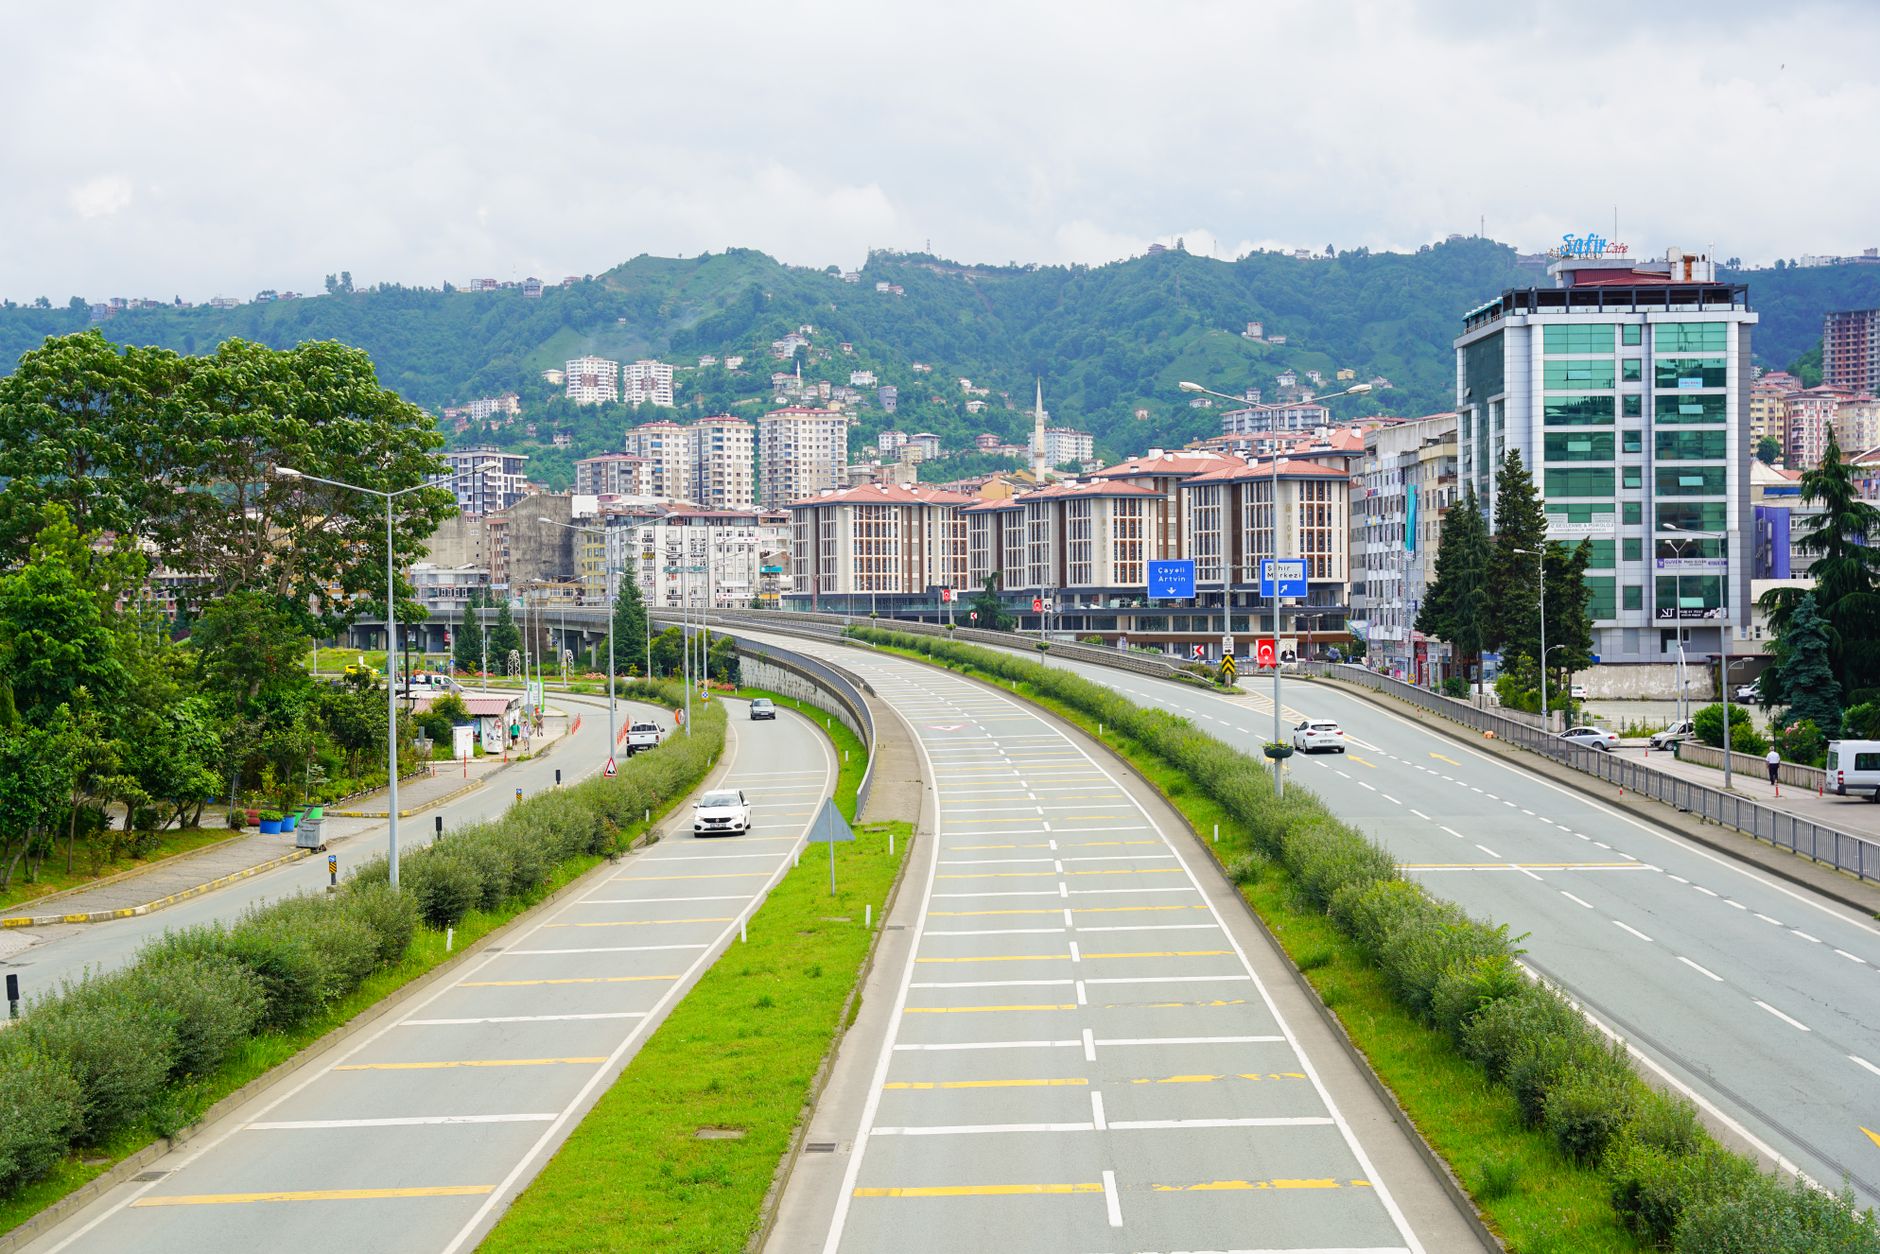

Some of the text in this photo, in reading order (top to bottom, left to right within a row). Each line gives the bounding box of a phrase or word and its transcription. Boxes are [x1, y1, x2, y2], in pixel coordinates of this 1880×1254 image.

[1560, 233, 1607, 257] Safir
[1157, 566, 1185, 574] Çayeli
[1267, 564, 1291, 572] Şhir
